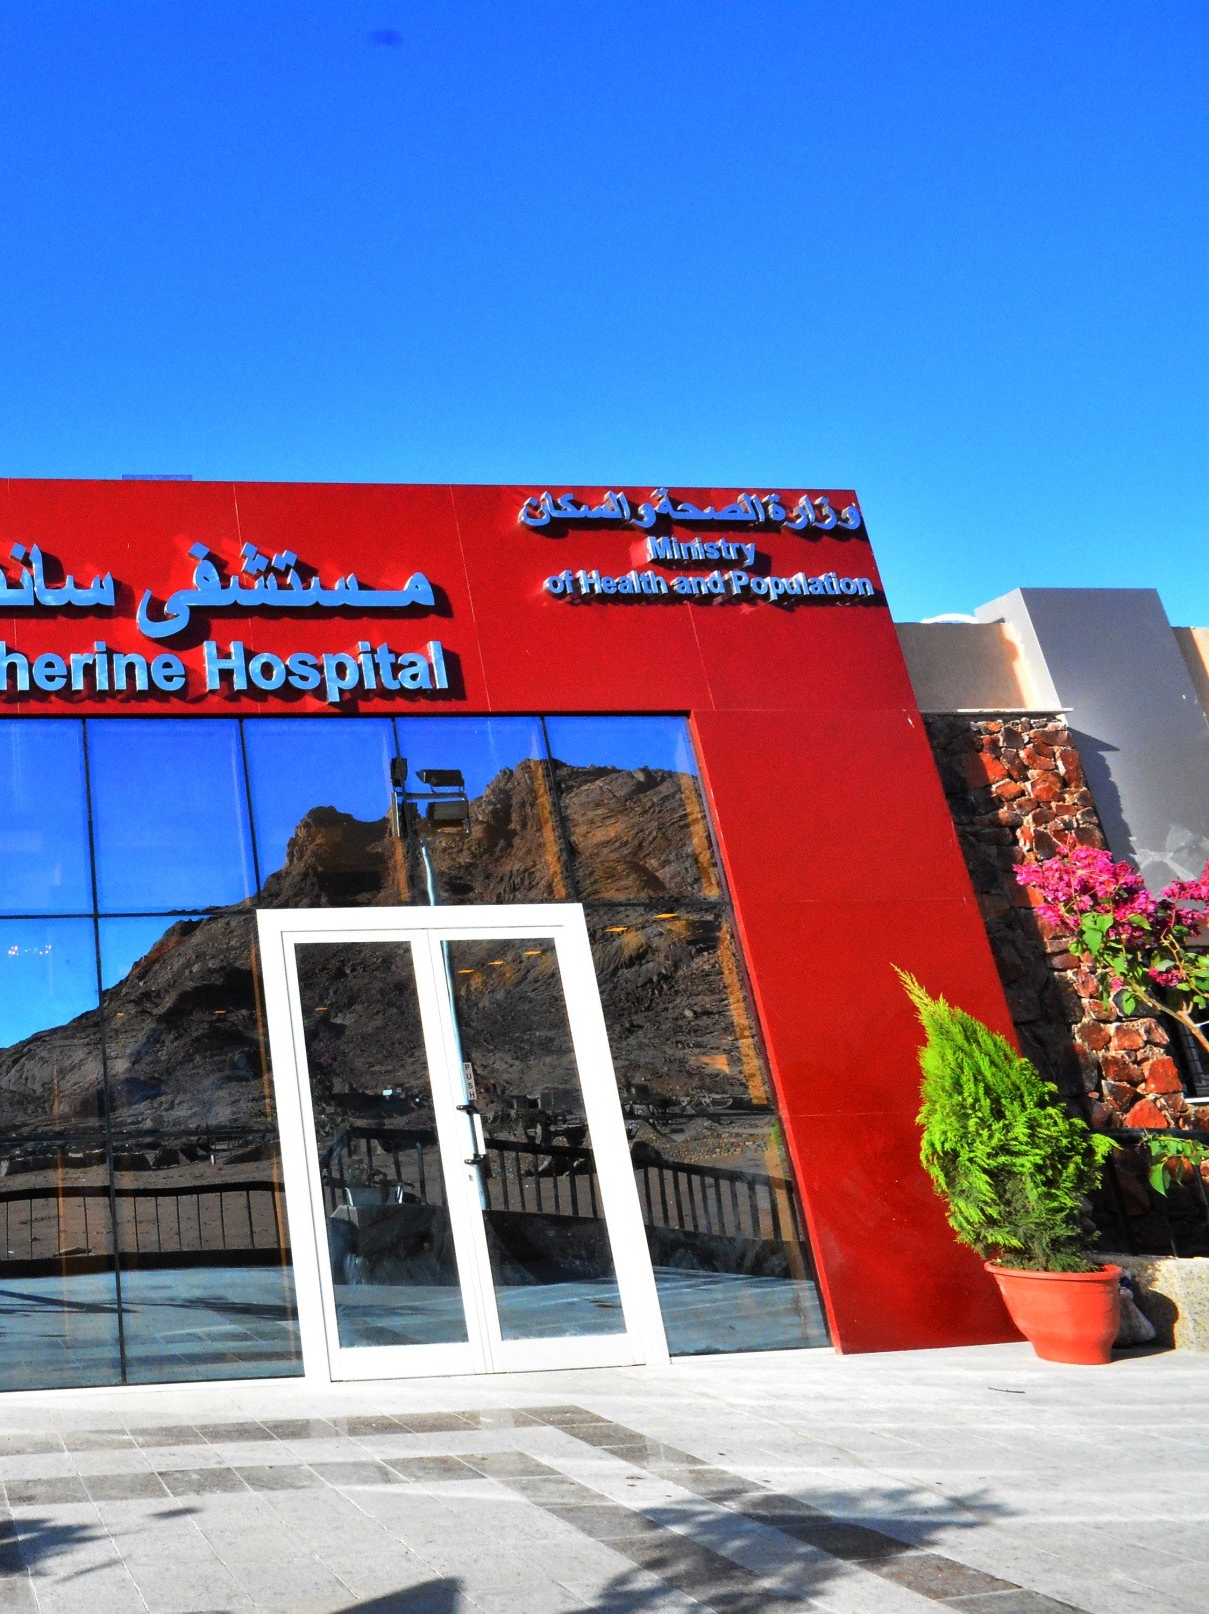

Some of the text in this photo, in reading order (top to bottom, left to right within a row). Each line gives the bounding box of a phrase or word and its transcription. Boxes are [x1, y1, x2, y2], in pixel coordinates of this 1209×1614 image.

[650, 487, 766, 524] الصحة
[762, 493, 861, 530] وزارة
[647, 536, 756, 566] Ministry
[135, 541, 435, 638] مستشفى
[546, 569, 875, 601] of Health and Population
[203, 640, 449, 702] Hospital
[464, 1063, 476, 1099] PUSH
